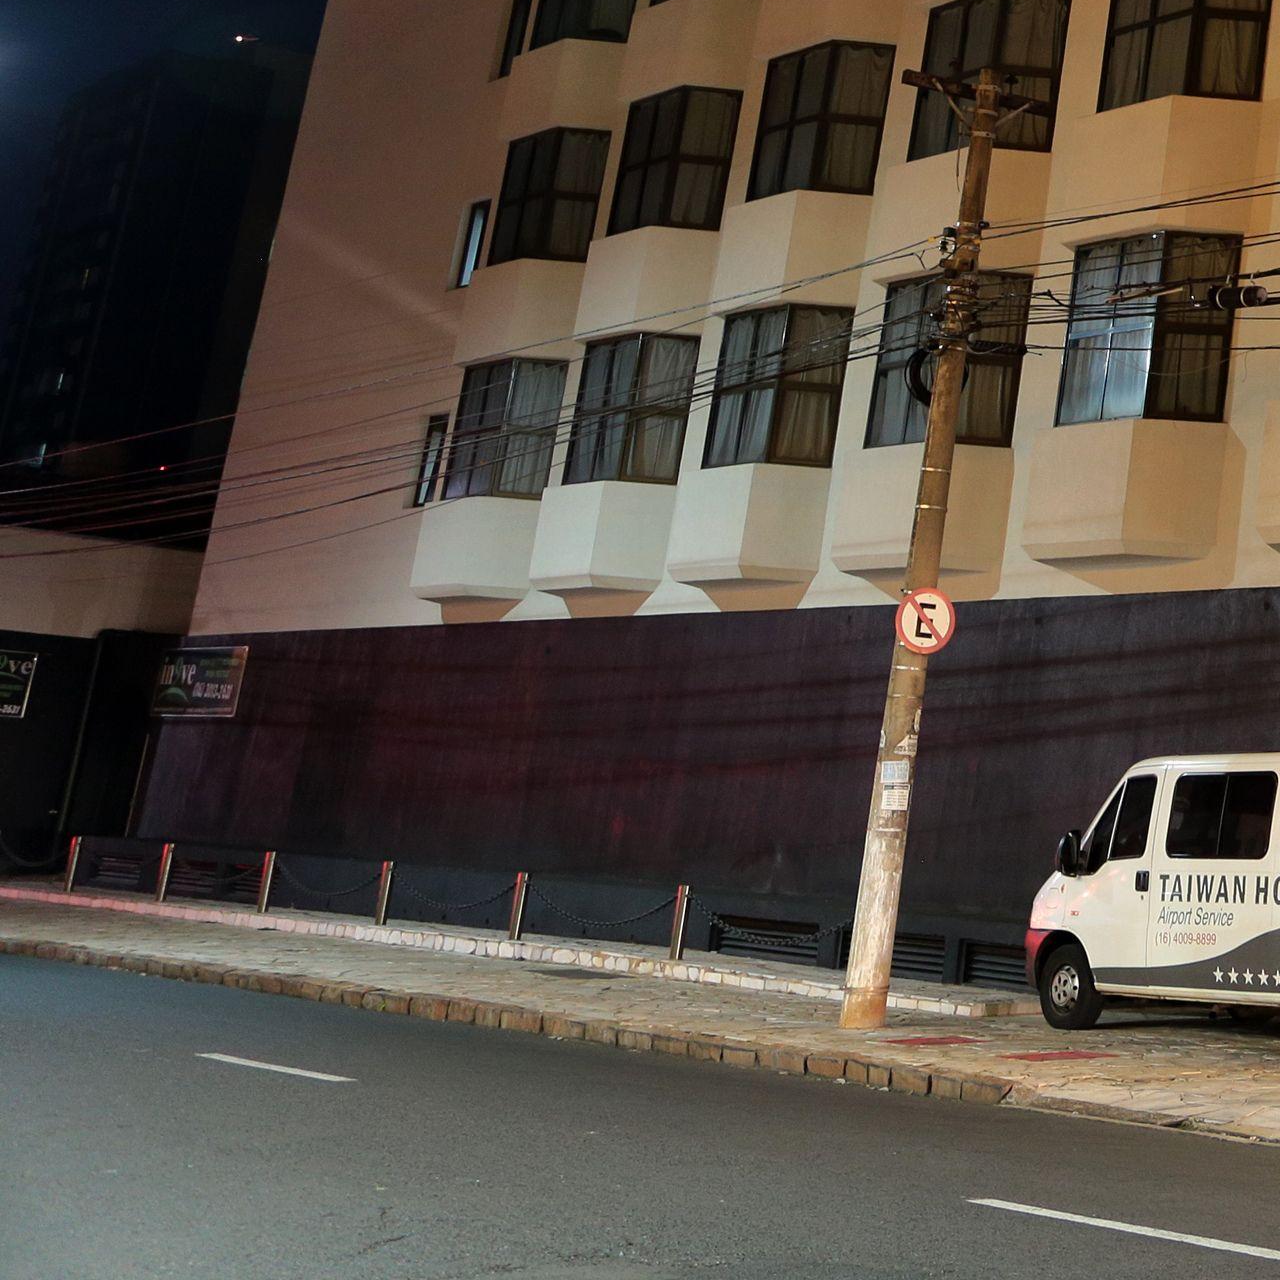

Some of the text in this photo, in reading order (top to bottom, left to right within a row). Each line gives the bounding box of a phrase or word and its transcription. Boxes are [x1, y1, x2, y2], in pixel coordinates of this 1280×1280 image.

[915, 602, 937, 639] E
[1159, 874, 1247, 905] TAIWAN
[1157, 906, 1234, 929] Airport Service
[1155, 932, 1217, 947] (16) 4009-8899
